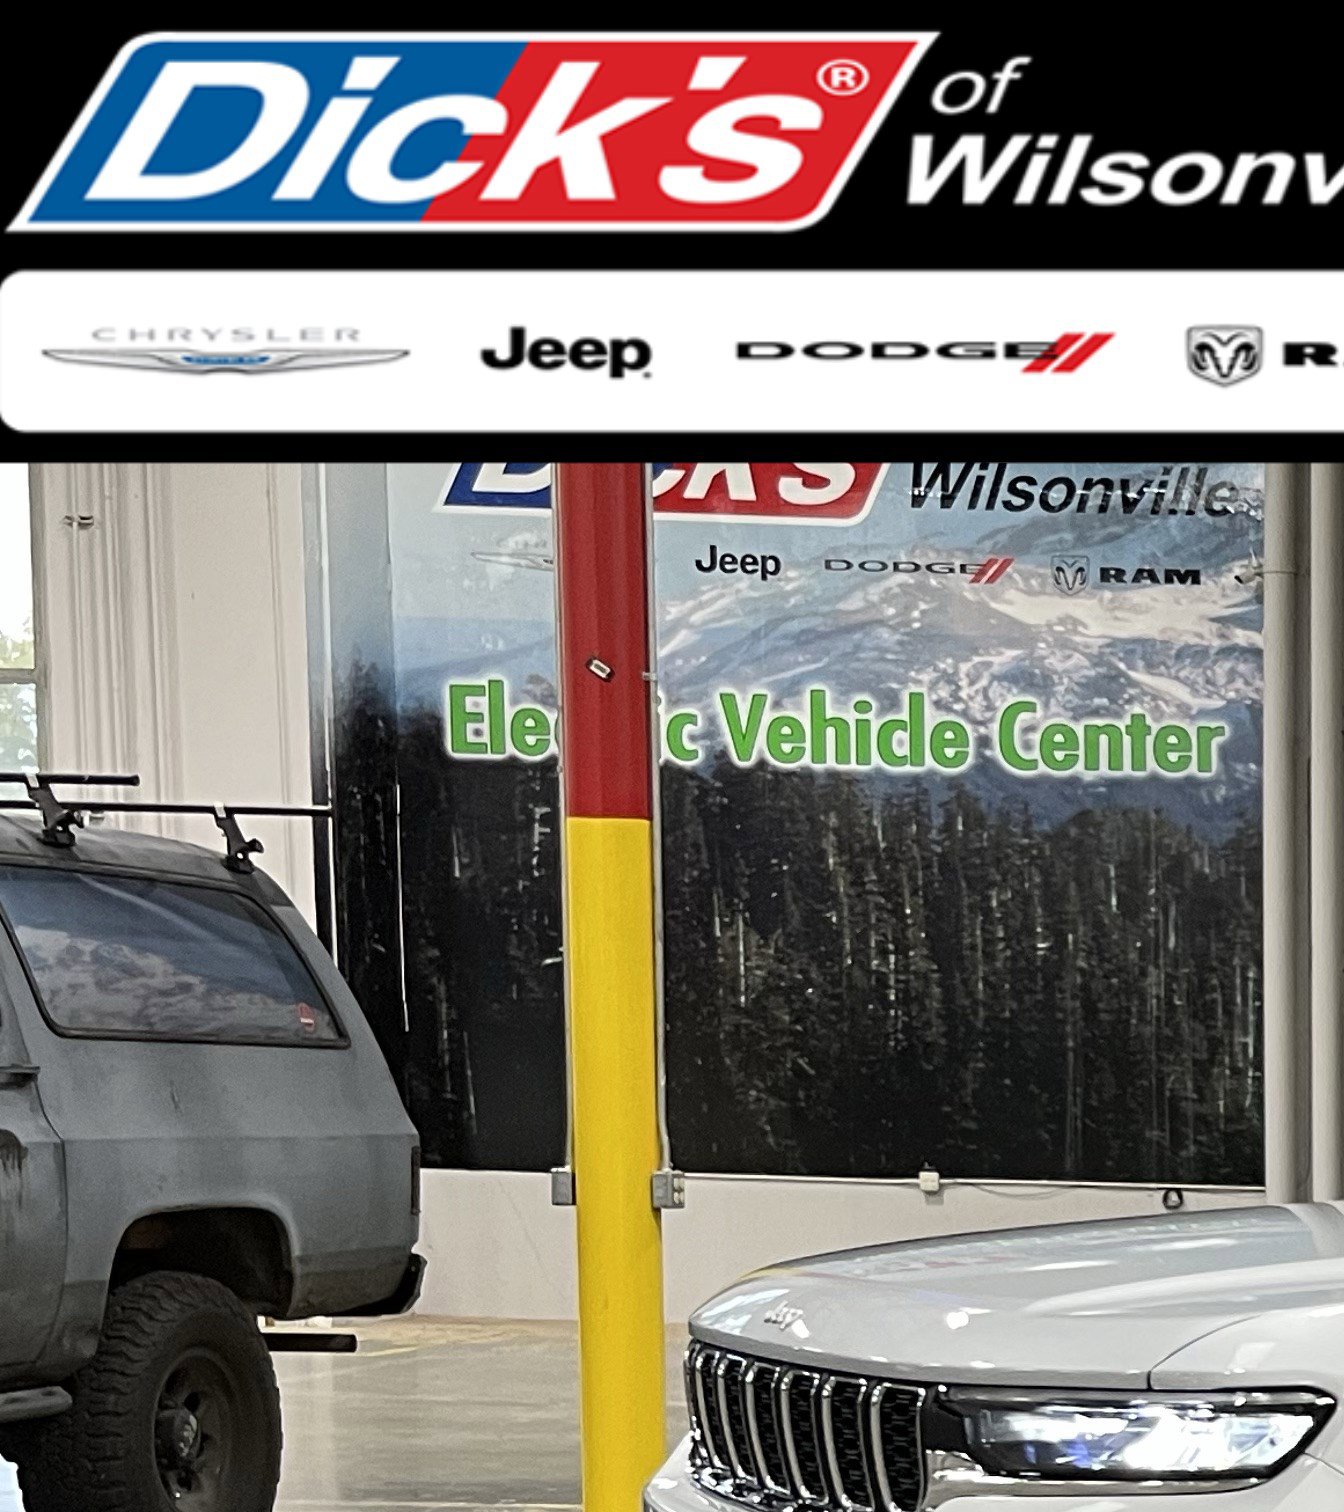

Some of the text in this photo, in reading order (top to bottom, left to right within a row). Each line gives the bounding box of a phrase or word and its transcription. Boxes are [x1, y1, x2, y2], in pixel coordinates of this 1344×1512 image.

[909, 462, 1239, 516] Wilsonville
[694, 544, 782, 581] Jeep
[824, 558, 983, 576] DODGE
[1099, 566, 1201, 586] RAM
[449, 679, 1226, 774] Elec Vehicle Center
